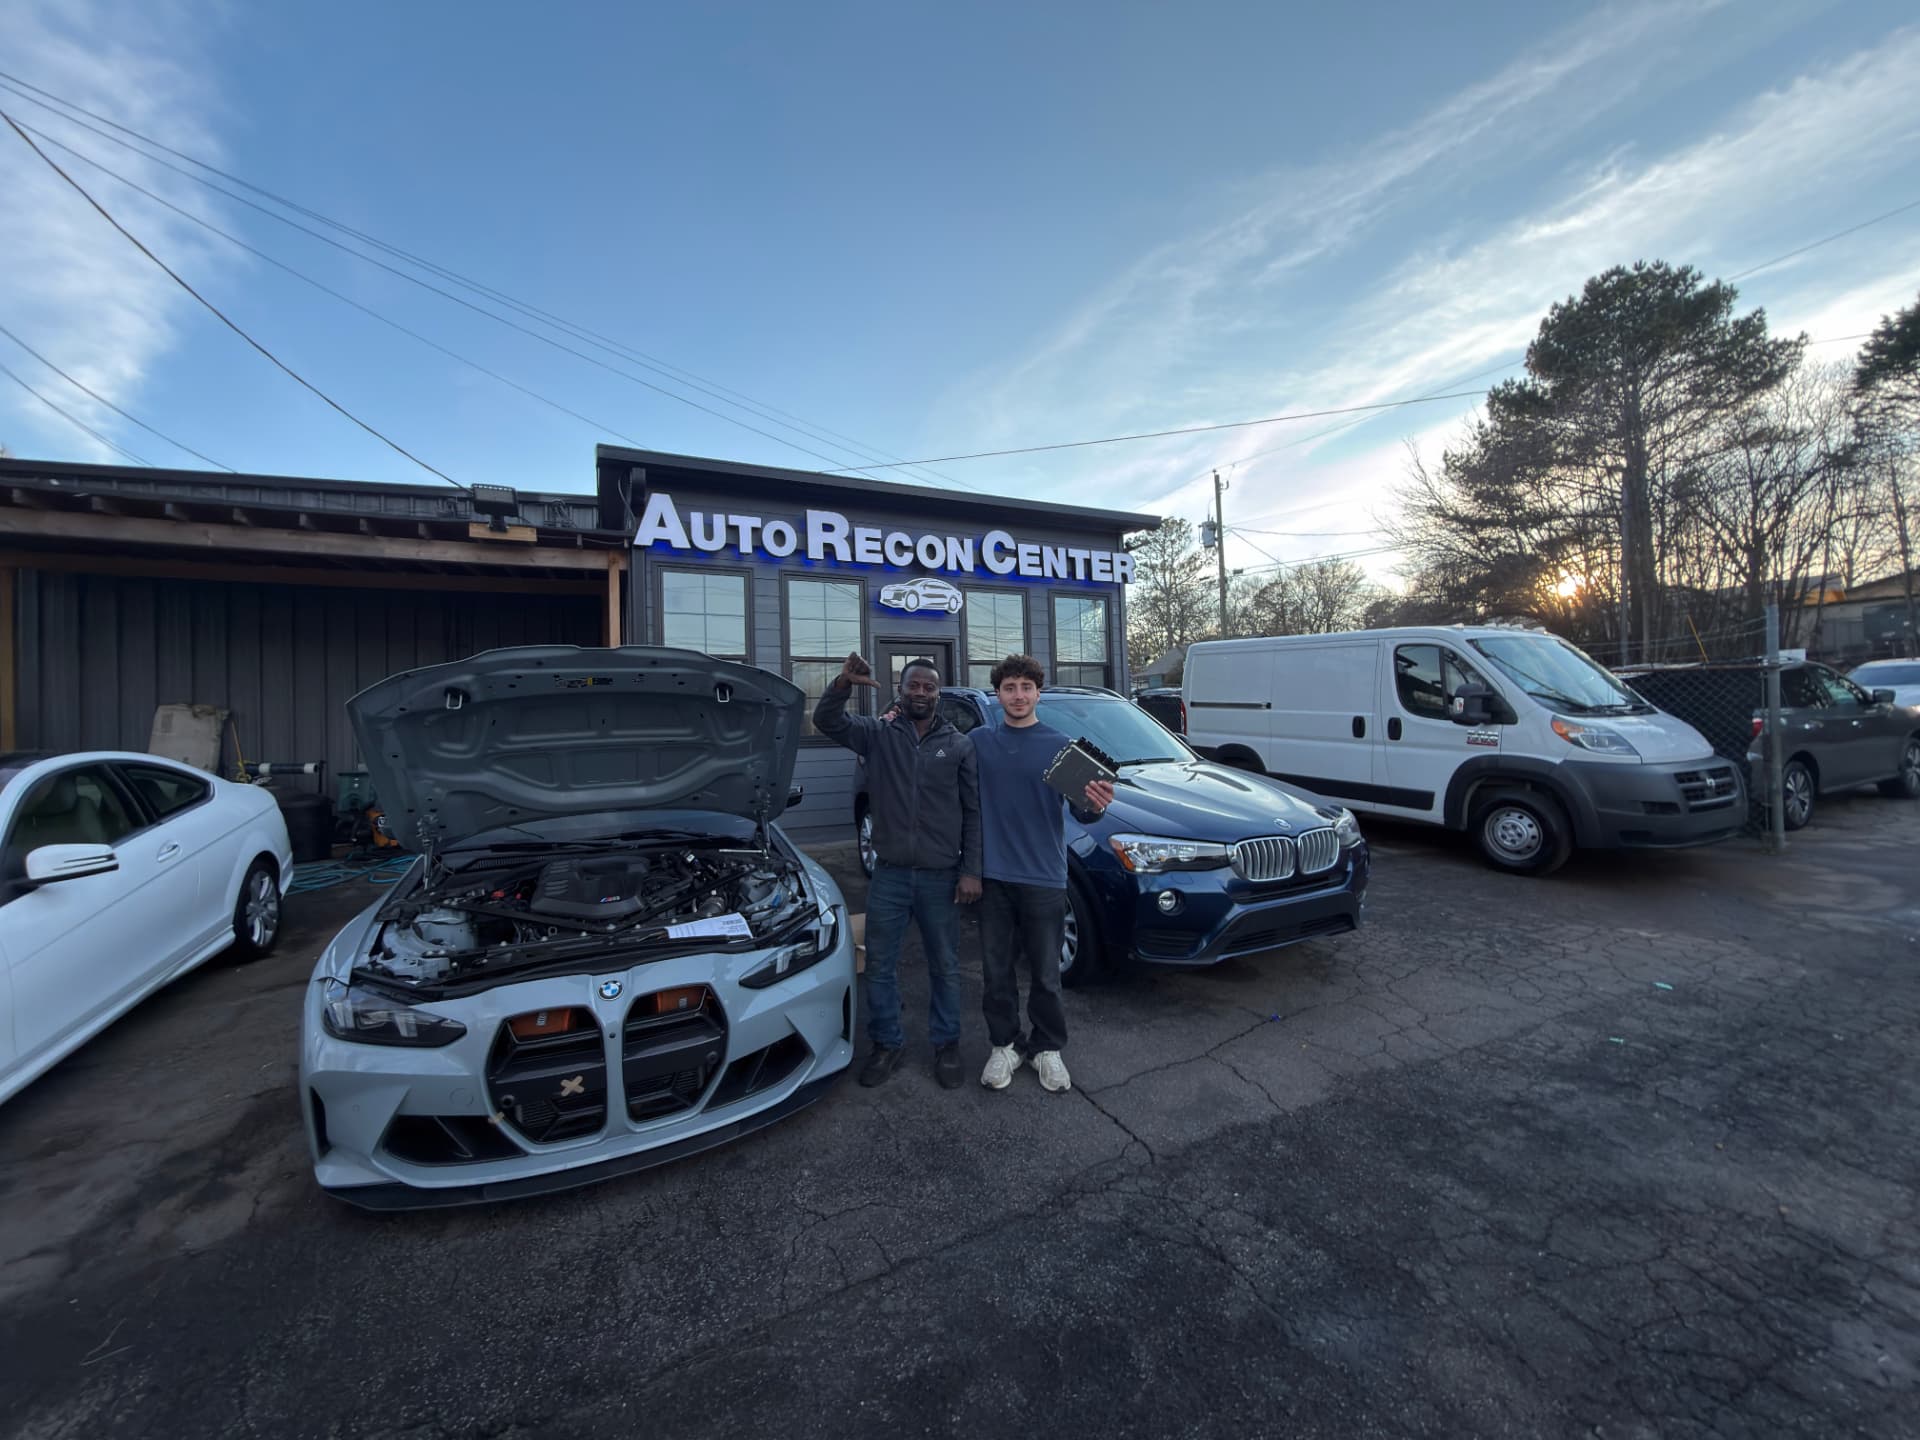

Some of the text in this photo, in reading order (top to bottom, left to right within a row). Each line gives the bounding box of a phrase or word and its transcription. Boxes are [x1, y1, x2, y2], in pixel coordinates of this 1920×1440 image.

[633, 492, 1136, 584] AUTO RECON CENTER
